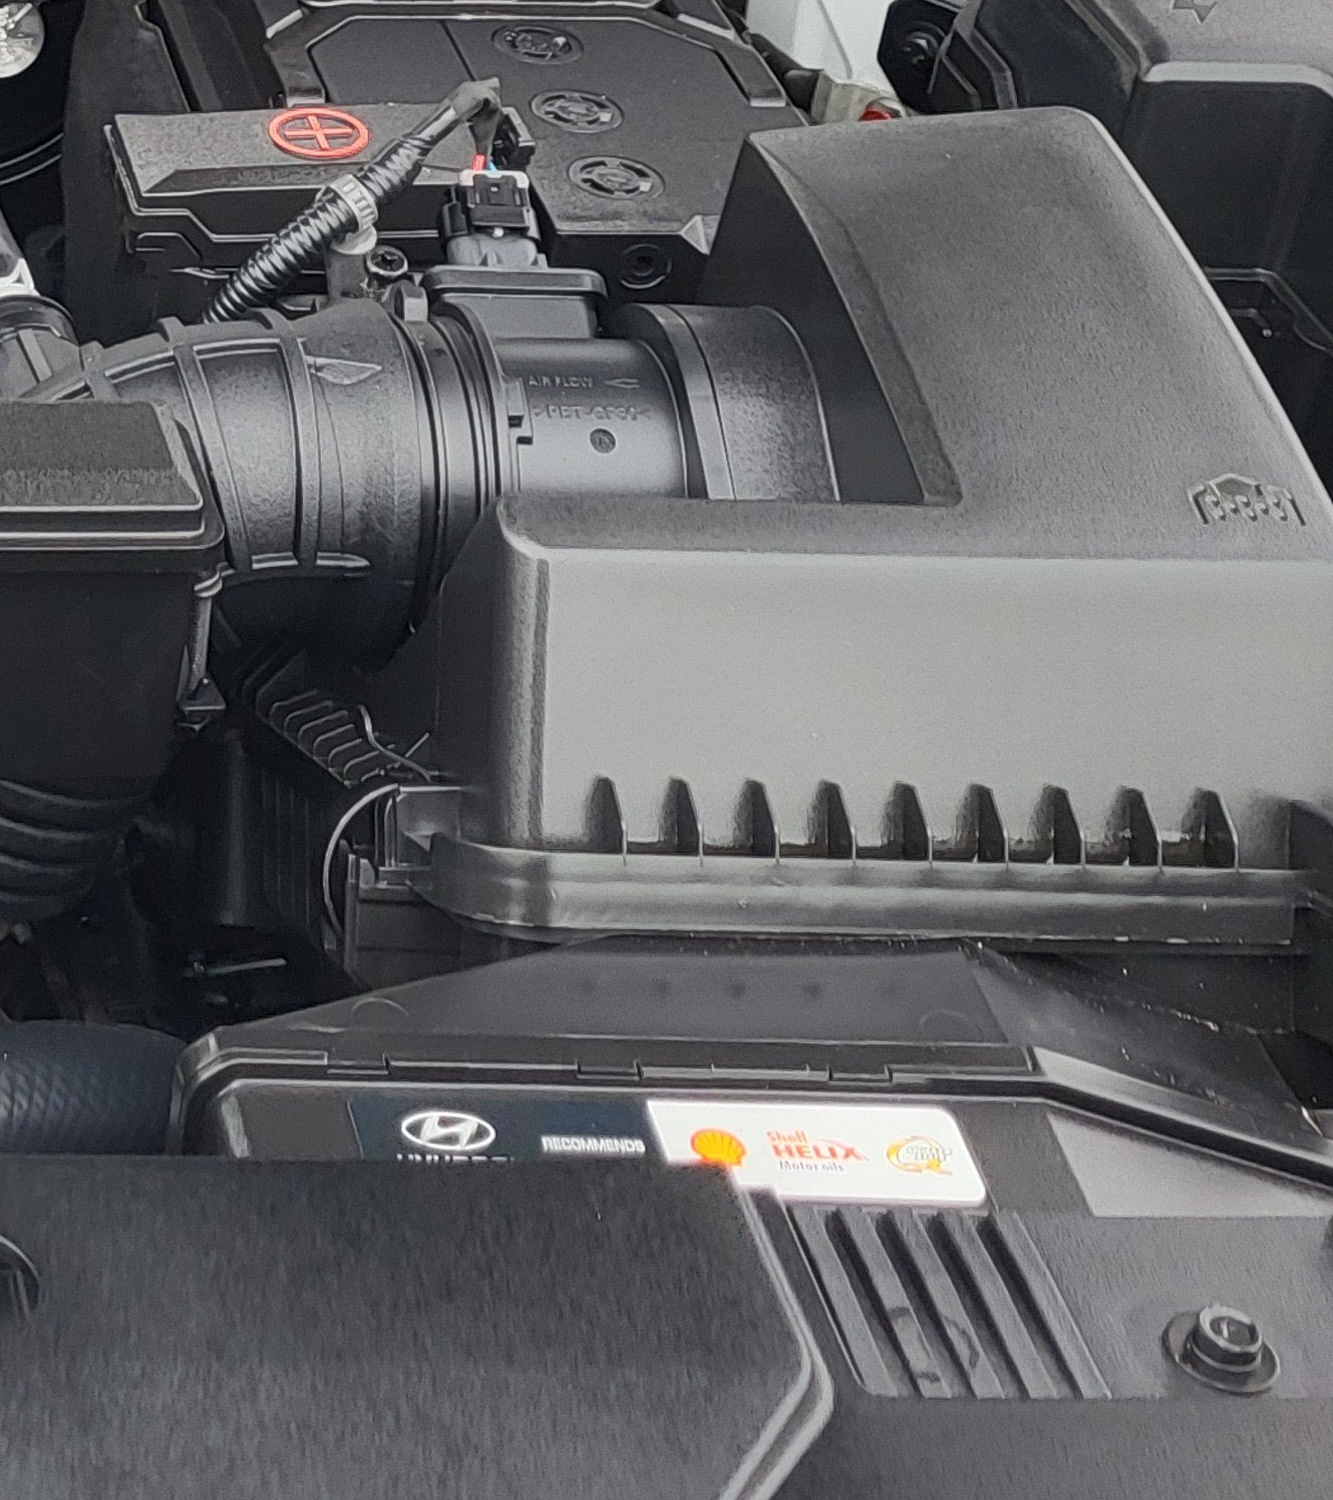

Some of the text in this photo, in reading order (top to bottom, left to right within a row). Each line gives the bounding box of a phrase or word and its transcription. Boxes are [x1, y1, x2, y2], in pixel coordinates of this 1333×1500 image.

[541, 1135, 646, 1154] RECOMMENDS
[766, 1130, 808, 1144] Shell
[772, 1144, 867, 1161] HELIX
[779, 1160, 844, 1172] Motor oils
